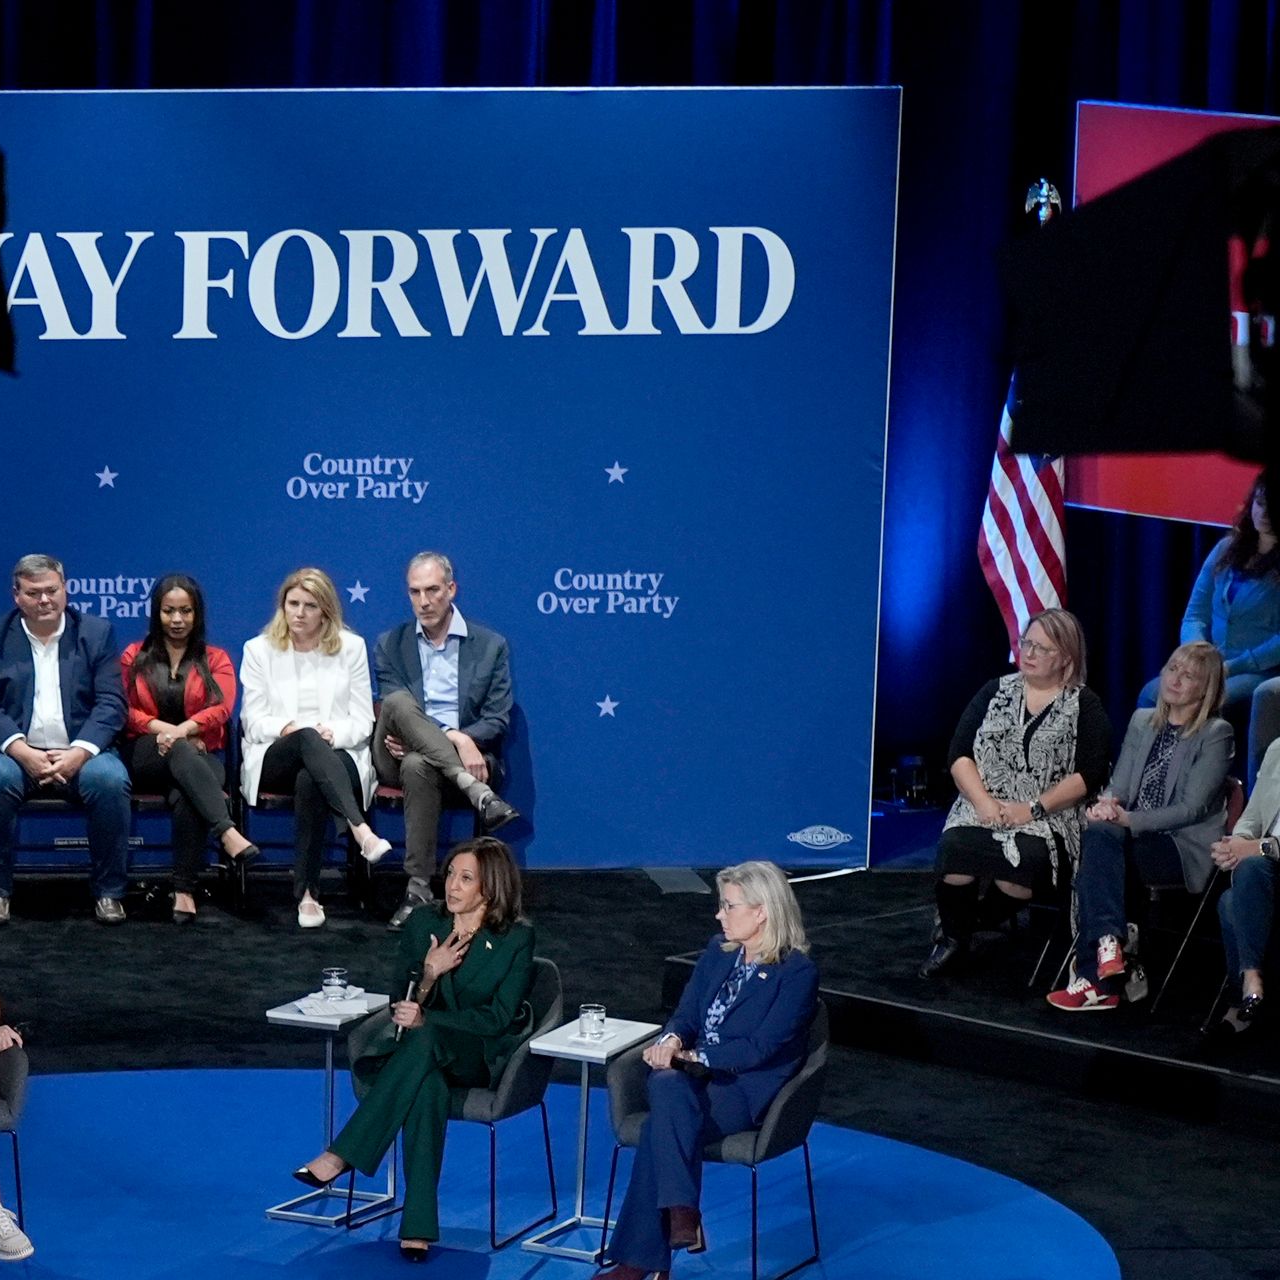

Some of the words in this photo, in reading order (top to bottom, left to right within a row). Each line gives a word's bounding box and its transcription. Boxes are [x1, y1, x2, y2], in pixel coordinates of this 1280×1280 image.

[172, 226, 796, 340] FORWARD
[303, 452, 414, 480] Country
[286, 476, 350, 500] Over
[355, 476, 430, 504] Party
[66, 574, 157, 599] ountry
[553, 567, 665, 595] Country
[99, 595, 152, 618] Part
[537, 591, 600, 614] Over
[606, 591, 680, 619] Party
